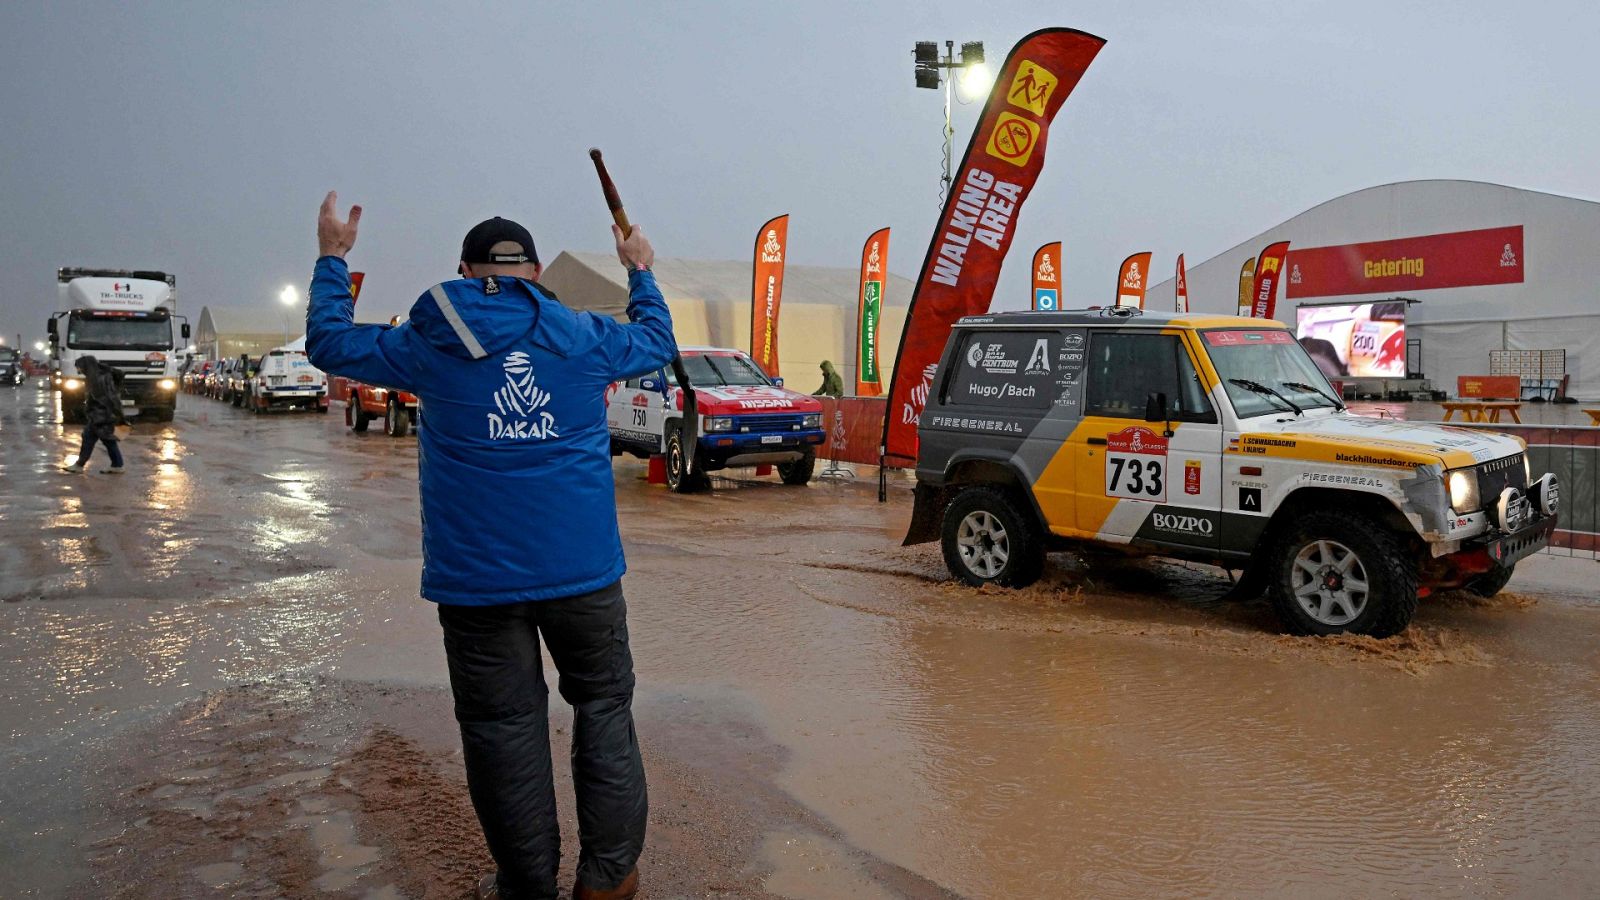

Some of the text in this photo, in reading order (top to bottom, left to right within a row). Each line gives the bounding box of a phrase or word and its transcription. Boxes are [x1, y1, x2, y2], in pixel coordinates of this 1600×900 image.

[974, 180, 1023, 250] AREA
[930, 168, 995, 287] WALKING
[762, 252, 782, 263] DAKAR
[1364, 256, 1425, 279] Catering
[1037, 272, 1057, 282] DAKAR
[1123, 279, 1142, 289] DAKAR
[1258, 279, 1272, 300] CLUB
[1353, 334, 1375, 351] 200
[982, 360, 1019, 368] CENTRUM
[1060, 353, 1083, 361] BOZPO
[739, 399, 793, 408] NISSAN
[487, 411, 560, 440] DAKAR
[632, 408, 647, 427] 750
[932, 416, 1023, 433] FIREGENERAL
[1336, 453, 1426, 468] blackhilloutdoor.com
[1109, 457, 1162, 496] 733
[1231, 480, 1269, 489] PAJERO
[1153, 512, 1213, 534] BOZPO
